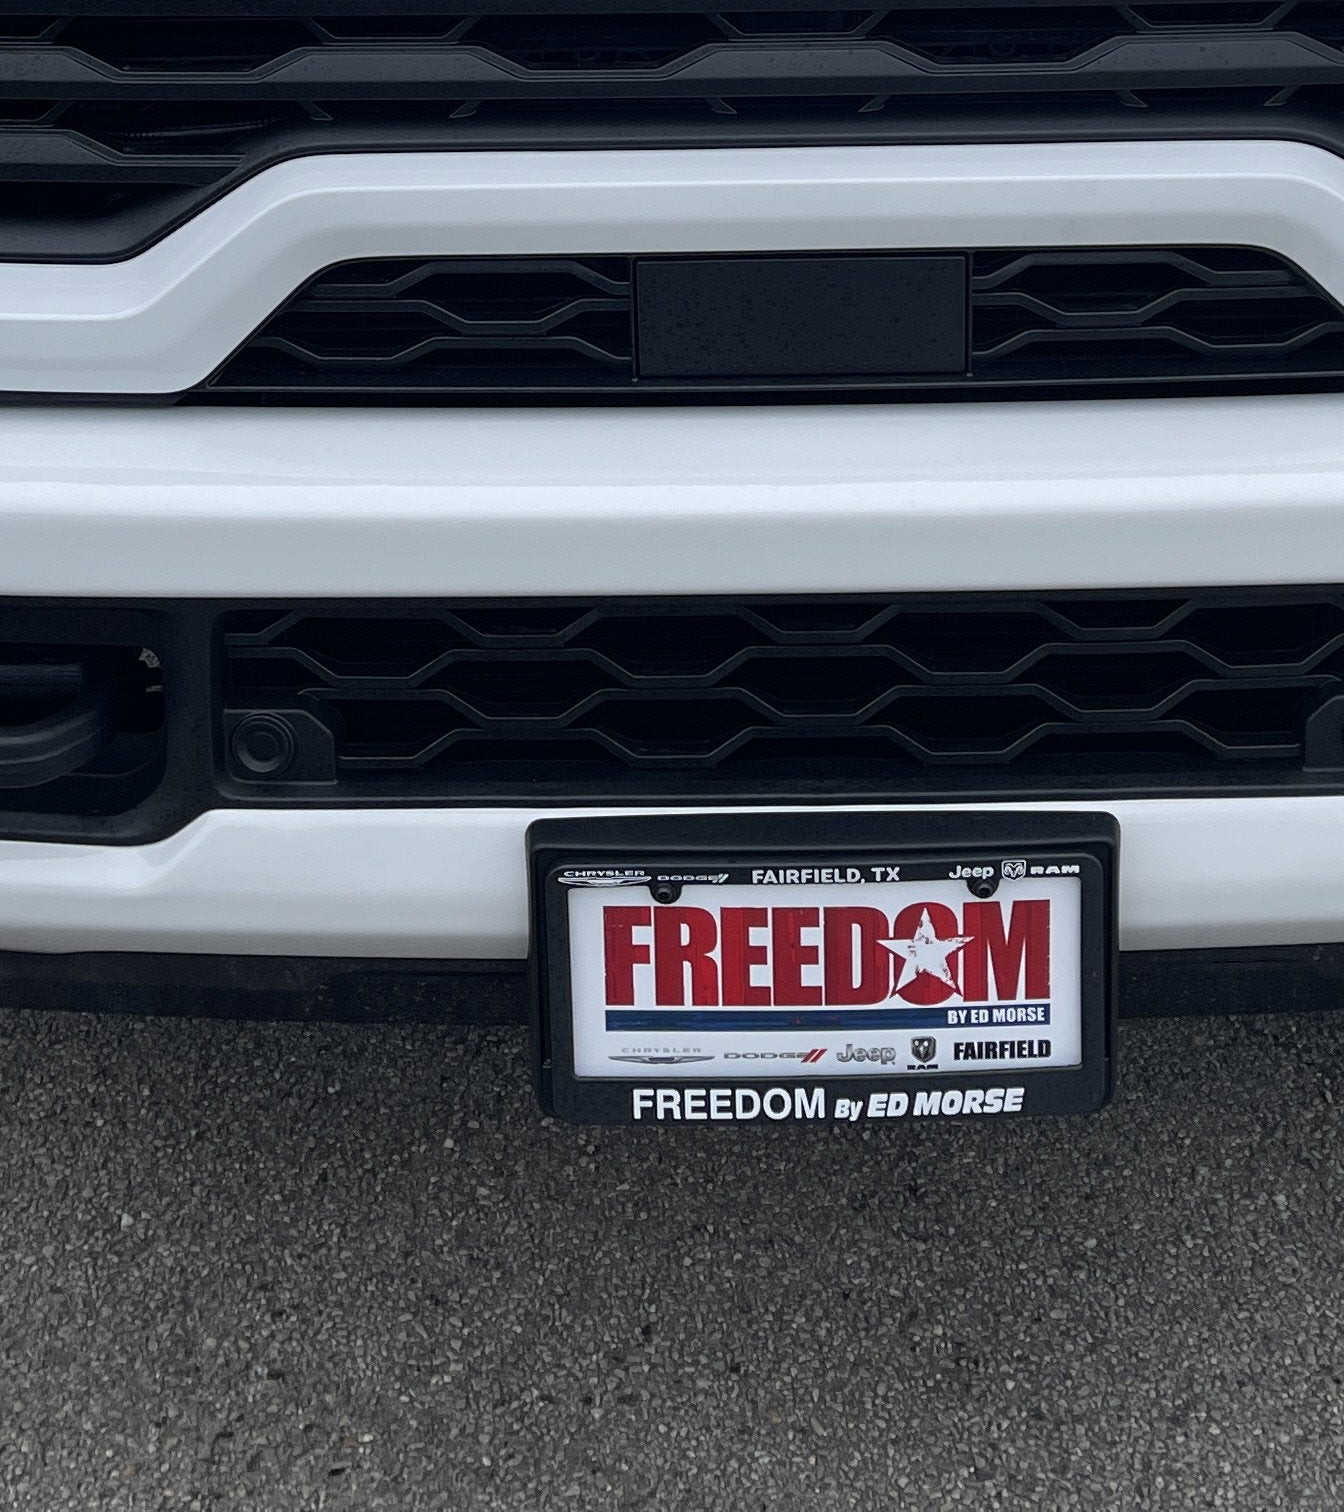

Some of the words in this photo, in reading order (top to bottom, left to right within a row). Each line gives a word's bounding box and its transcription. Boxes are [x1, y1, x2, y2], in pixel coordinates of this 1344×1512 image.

[563, 870, 645, 878] CHRYSLER
[657, 874, 718, 883] DODGE
[751, 868, 866, 884] FAIRFIELD,
[871, 867, 900, 882] TX
[949, 865, 995, 880] Jeep
[1030, 865, 1080, 875] RAM
[603, 899, 1051, 1007] FREEDOM
[947, 1010, 968, 1025] BY
[971, 1009, 989, 1023] ED
[992, 1007, 1045, 1023] MORSE
[723, 1052, 808, 1060] DODGE
[836, 1043, 897, 1065] Jeep
[953, 1039, 1051, 1061] FAIRFIELD
[632, 1088, 826, 1121] FREEDOM
[834, 1098, 862, 1121] By
[867, 1093, 909, 1118] ED
[912, 1087, 1026, 1116] MORSE
